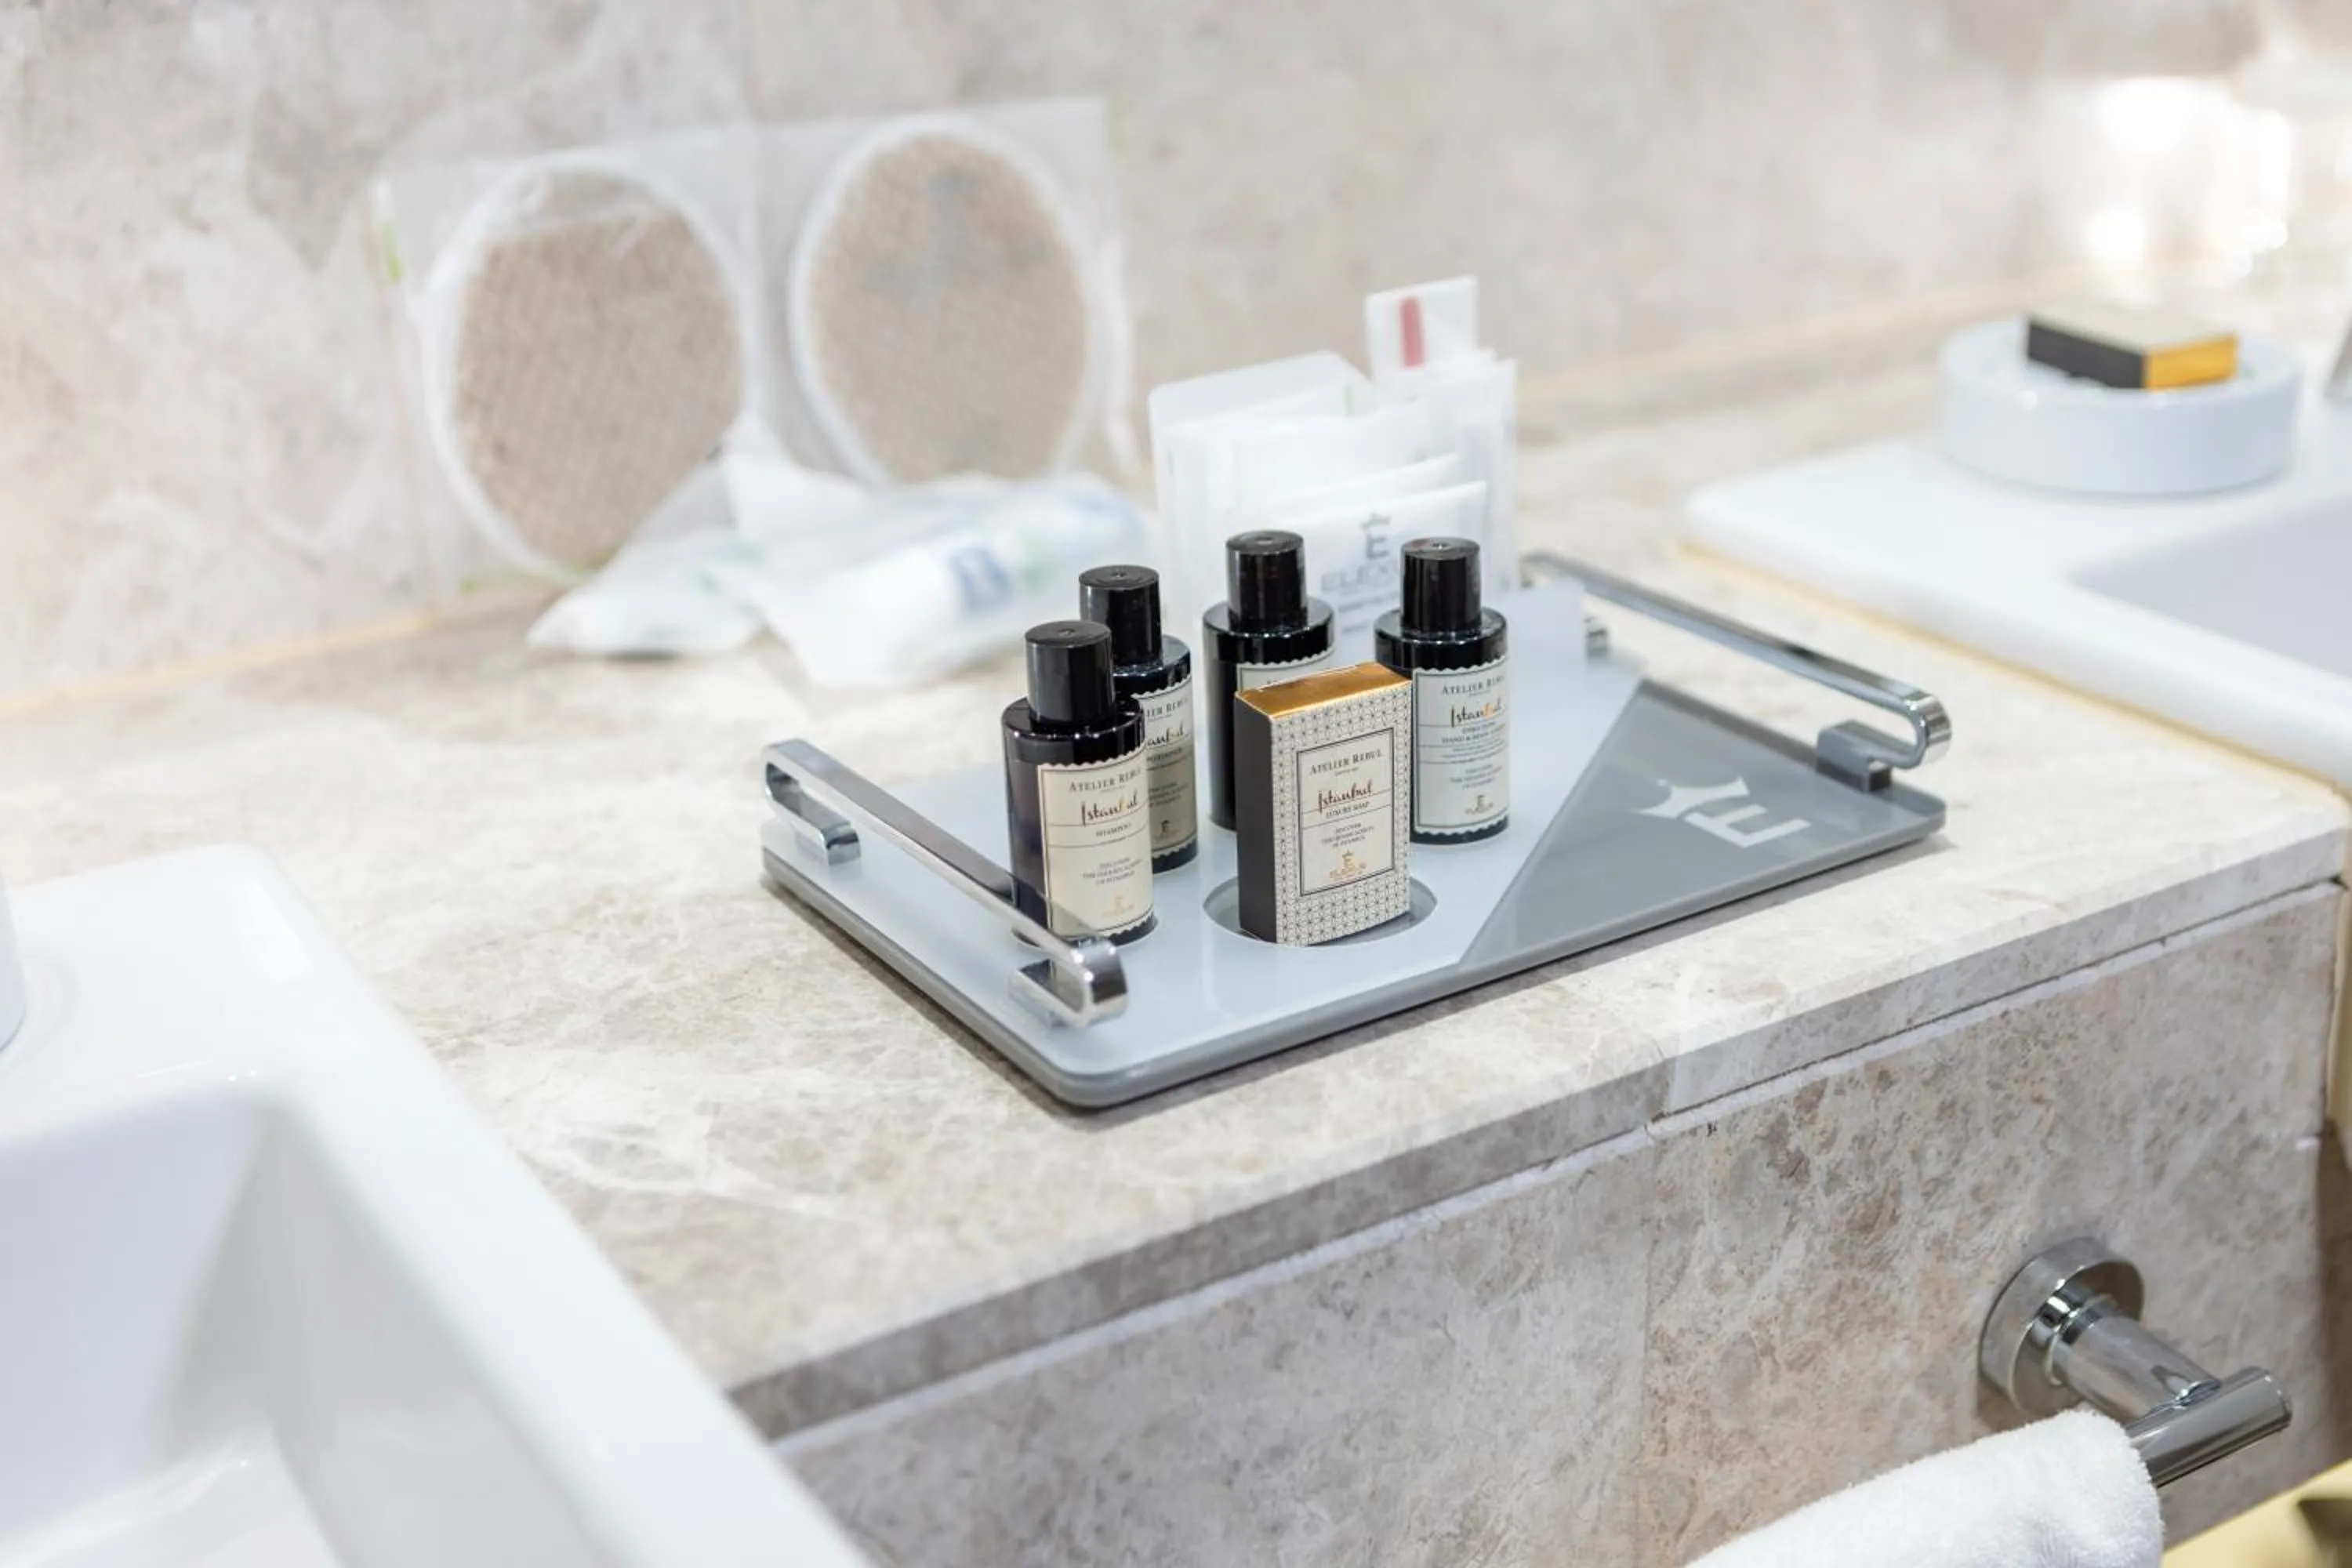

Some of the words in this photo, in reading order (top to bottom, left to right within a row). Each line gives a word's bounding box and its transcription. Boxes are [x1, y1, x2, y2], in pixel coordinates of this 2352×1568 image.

[1309, 758, 1349, 775] ATELIER
[1068, 777, 1116, 793] ATELIER
[1318, 779, 1372, 814] Istanbul
